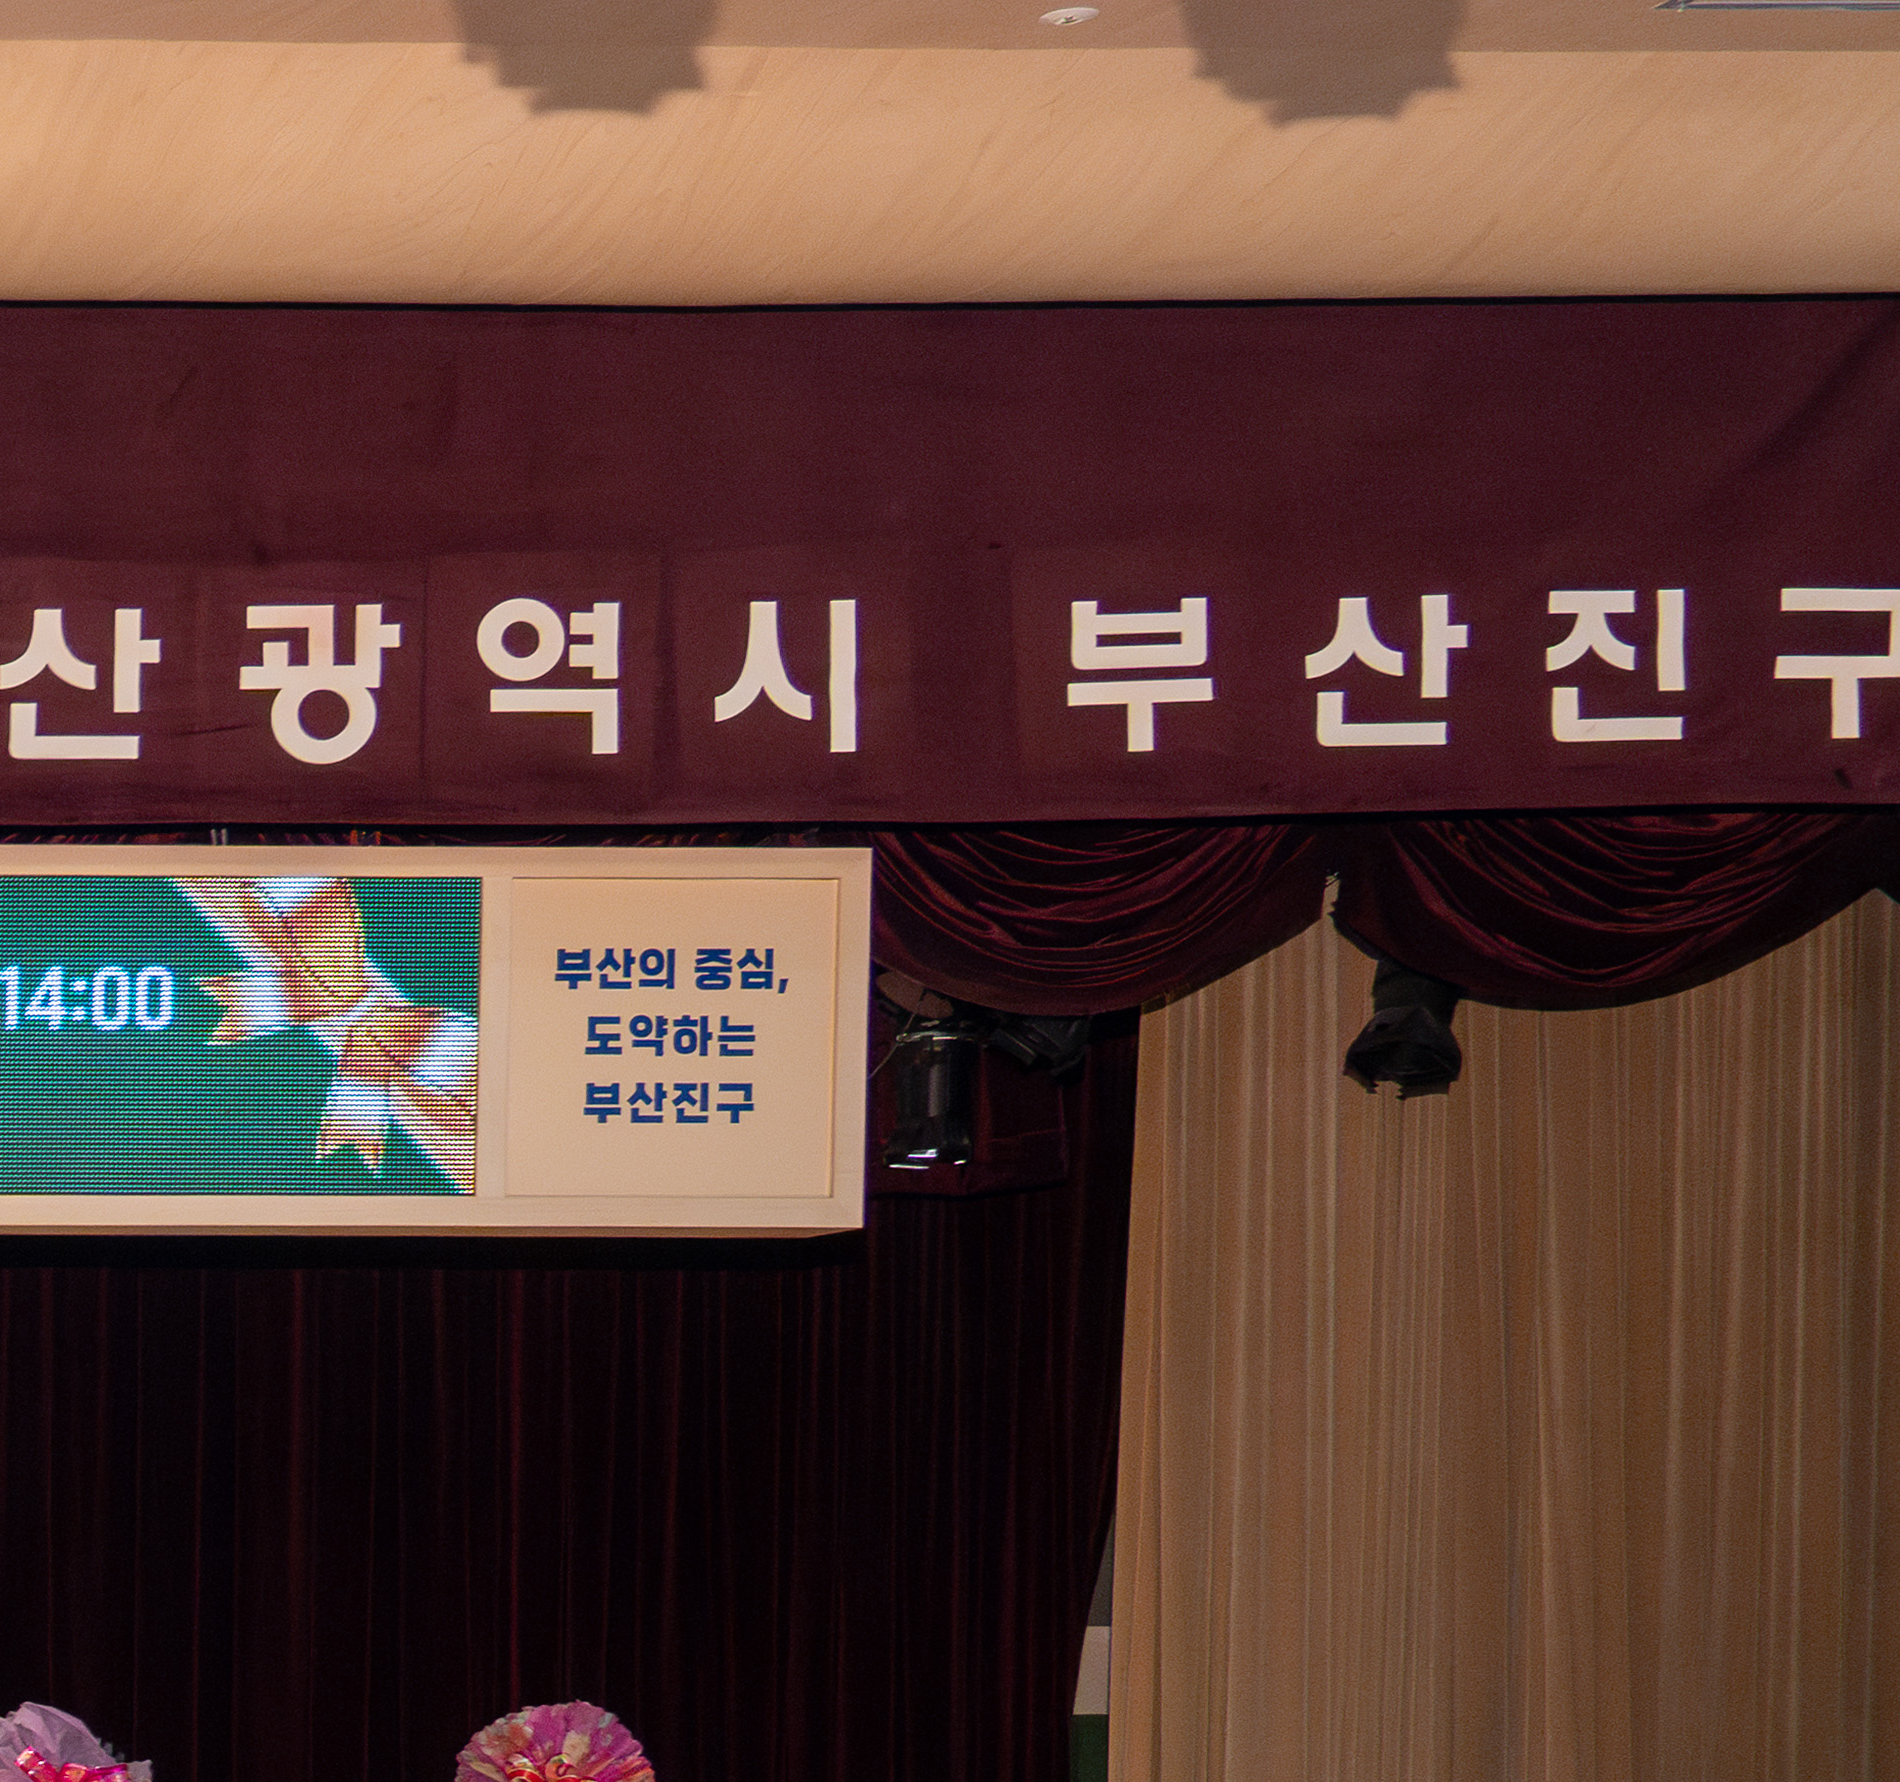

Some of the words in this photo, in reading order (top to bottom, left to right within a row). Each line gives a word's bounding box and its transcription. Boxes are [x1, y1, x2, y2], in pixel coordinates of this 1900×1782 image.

[1066, 587, 1900, 752] 부산진구
[554, 948, 676, 990] 부산의
[694, 948, 789, 994] 중심,
[584, 1014, 756, 1057] 도약하는
[583, 1082, 755, 1124] 부산진구
